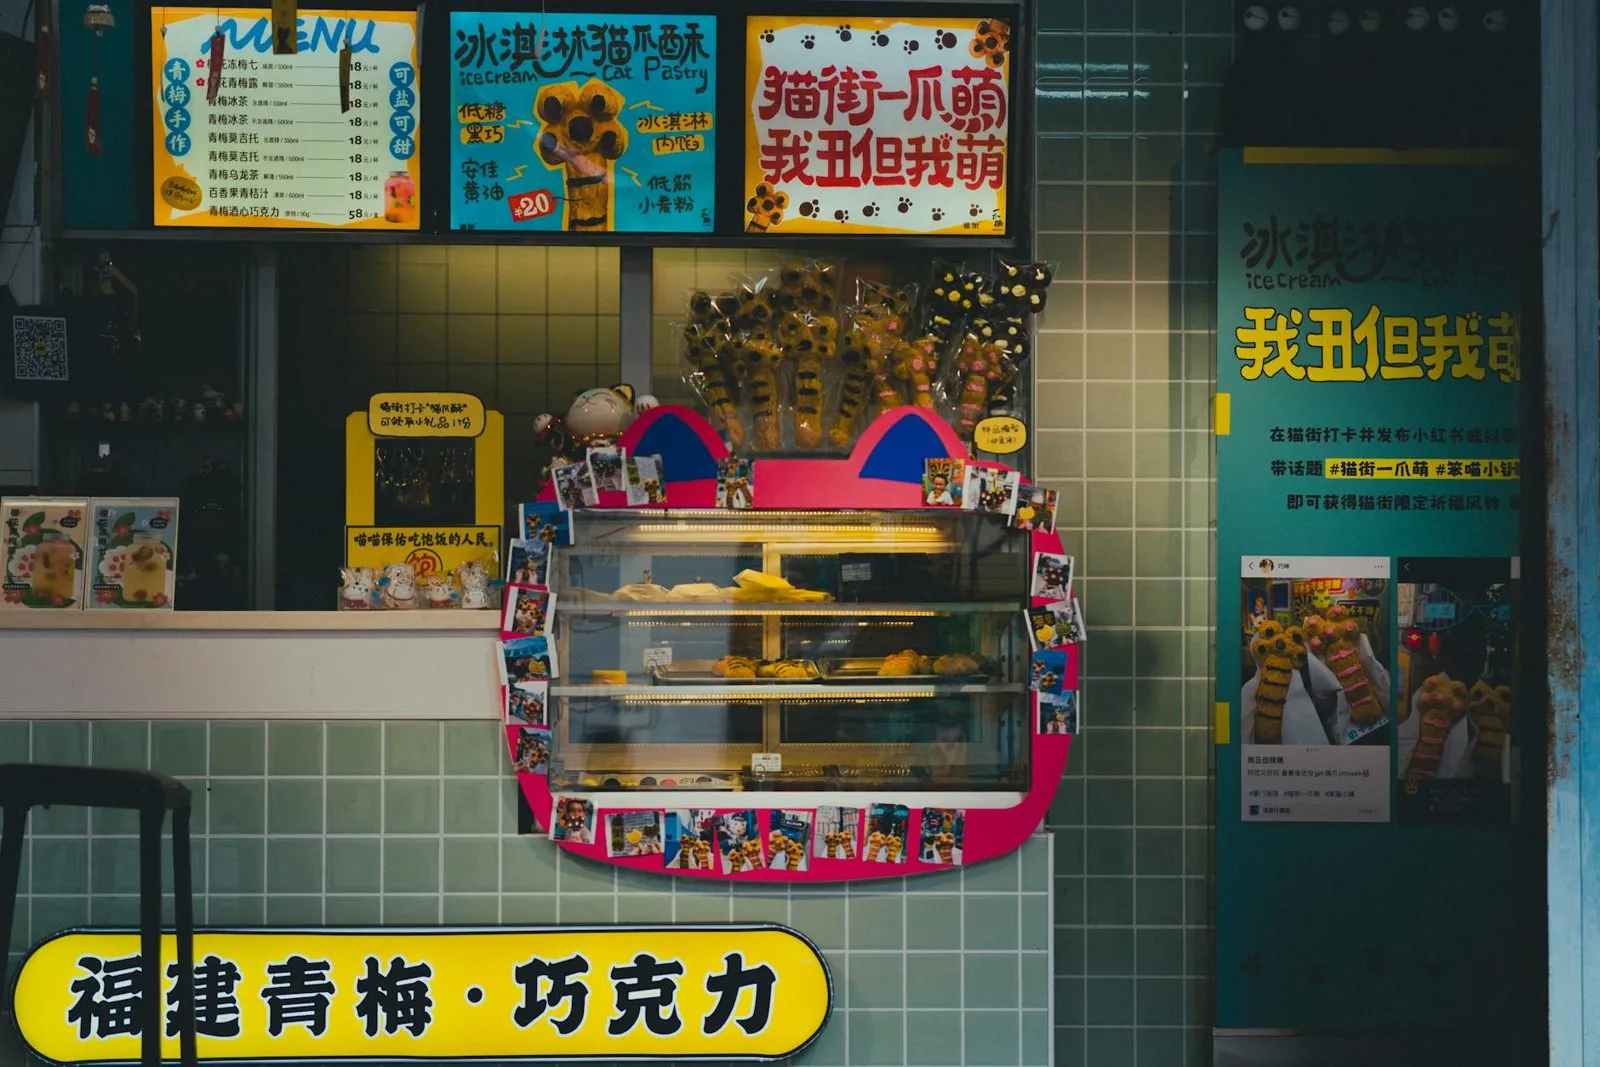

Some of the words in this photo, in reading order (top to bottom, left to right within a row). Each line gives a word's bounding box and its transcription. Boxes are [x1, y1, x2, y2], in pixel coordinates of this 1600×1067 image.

[200, 15, 380, 54] MENU
[454, 22, 710, 78] 冰淇淋猫爪酥
[207, 59, 258, 71] 花冻梅七
[350, 62, 362, 72] 18
[644, 56, 709, 94] Pastry
[350, 80, 362, 90] 18
[460, 70, 483, 86] ice
[168, 62, 188, 152] 青梅手作
[349, 98, 362, 108] 18
[758, 64, 1007, 133] 猫街一爪萌
[208, 113, 248, 125] 青梅冰茶
[349, 117, 362, 127] 18
[393, 66, 413, 155] 可盐可甜
[458, 101, 506, 120] 低糖
[637, 111, 709, 132] 冰淇淋
[208, 132, 259, 144] 青梅莫吉托
[349, 135, 362, 145] 18
[466, 121, 504, 143] 黑巧
[655, 135, 701, 152] 内馅
[208, 151, 259, 162] 青梅莫吉托
[349, 154, 362, 163] 18
[759, 127, 1005, 190] 我丑但我萌
[208, 169, 259, 181] 青梅乌龙茶
[349, 172, 362, 182] 18
[461, 158, 500, 178] 安佳
[462, 180, 504, 204] 黄油
[647, 173, 693, 192] 低筋
[208, 187, 269, 199] 百香果青桔汁
[349, 190, 362, 200] 18
[208, 205, 279, 218] 青梅酒心巧克力
[349, 208, 363, 220] 58
[514, 192, 550, 218] ¥20
[638, 195, 695, 214] 小麦粉
[1270, 460, 1322, 477] 带话题
[1329, 460, 1429, 478] #猫街一爪萌
[354, 532, 494, 547] 喵喵保佑吃饱饭的人民。
